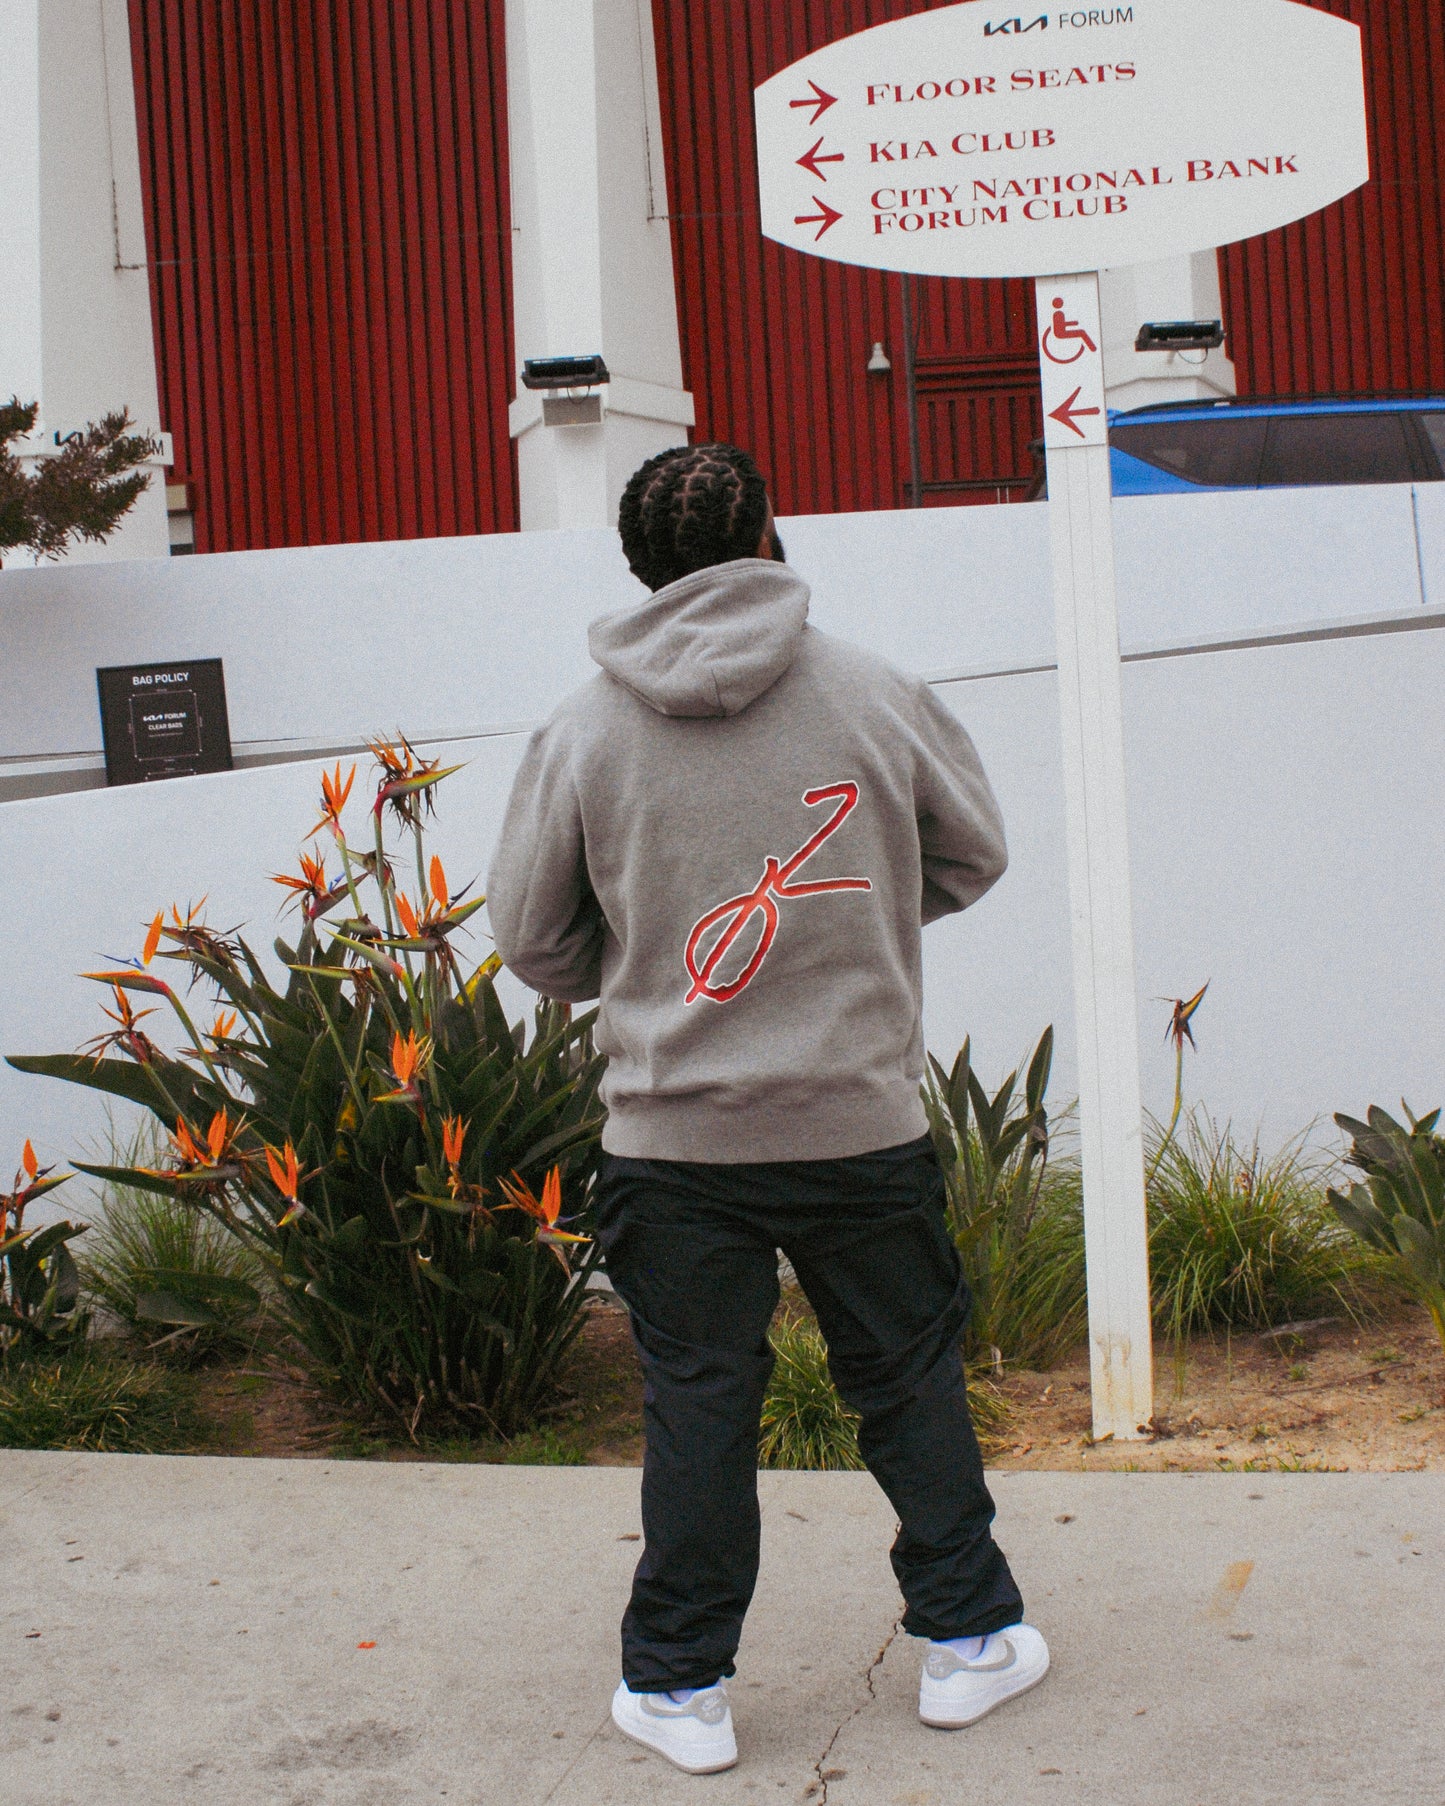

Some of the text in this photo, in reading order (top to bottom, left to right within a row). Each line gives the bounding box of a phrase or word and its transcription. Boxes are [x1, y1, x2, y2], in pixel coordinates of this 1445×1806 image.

[984, 6, 1133, 36] KIA FORUM
[866, 62, 1137, 106] FLOOR SEATS
[869, 128, 1056, 163] KIA CLUB
[870, 155, 1299, 211] CITY NATIONAL BANK
[873, 195, 1129, 235] FORUM CLUB
[132, 672, 190, 686] BAG POLICY
[164, 712, 187, 720] FORUM
